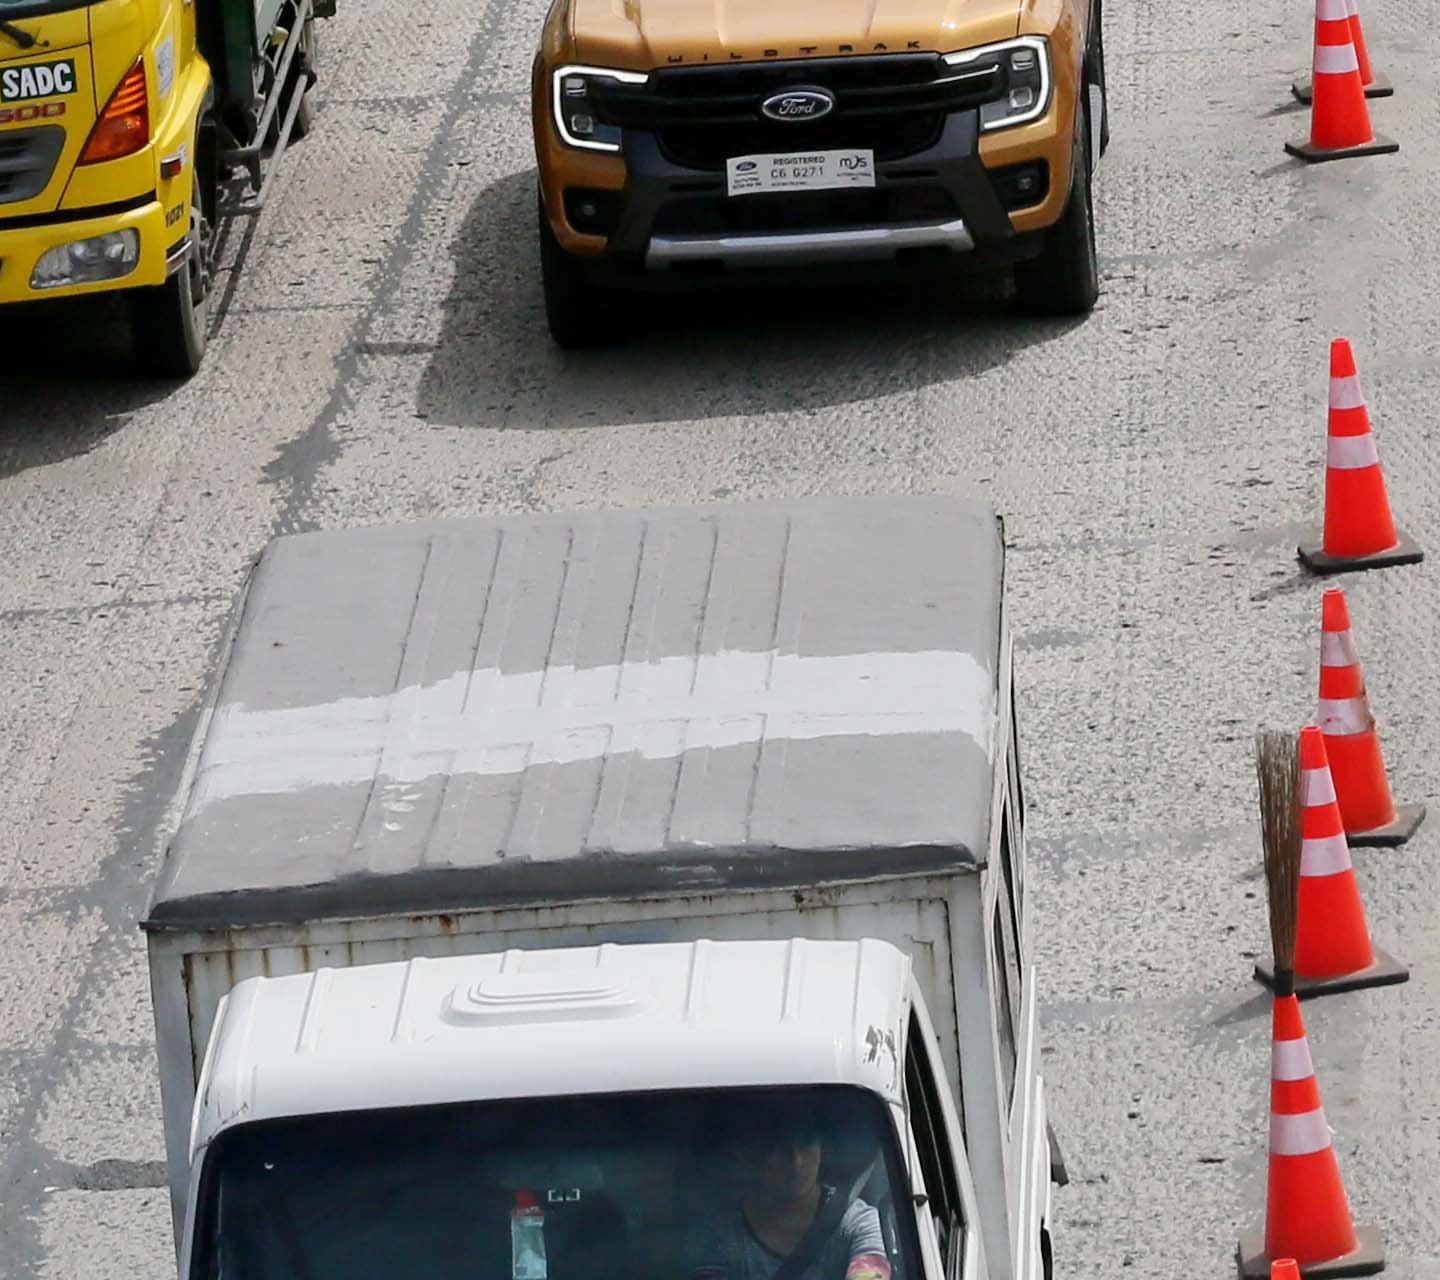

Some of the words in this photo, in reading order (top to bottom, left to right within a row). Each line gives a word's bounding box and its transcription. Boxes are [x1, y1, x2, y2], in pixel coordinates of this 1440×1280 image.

[668, 40, 922, 64] WILDTRAK
[3, 62, 72, 100] SADC
[778, 97, 817, 115] Ford
[772, 155, 827, 166] REGISTERED
